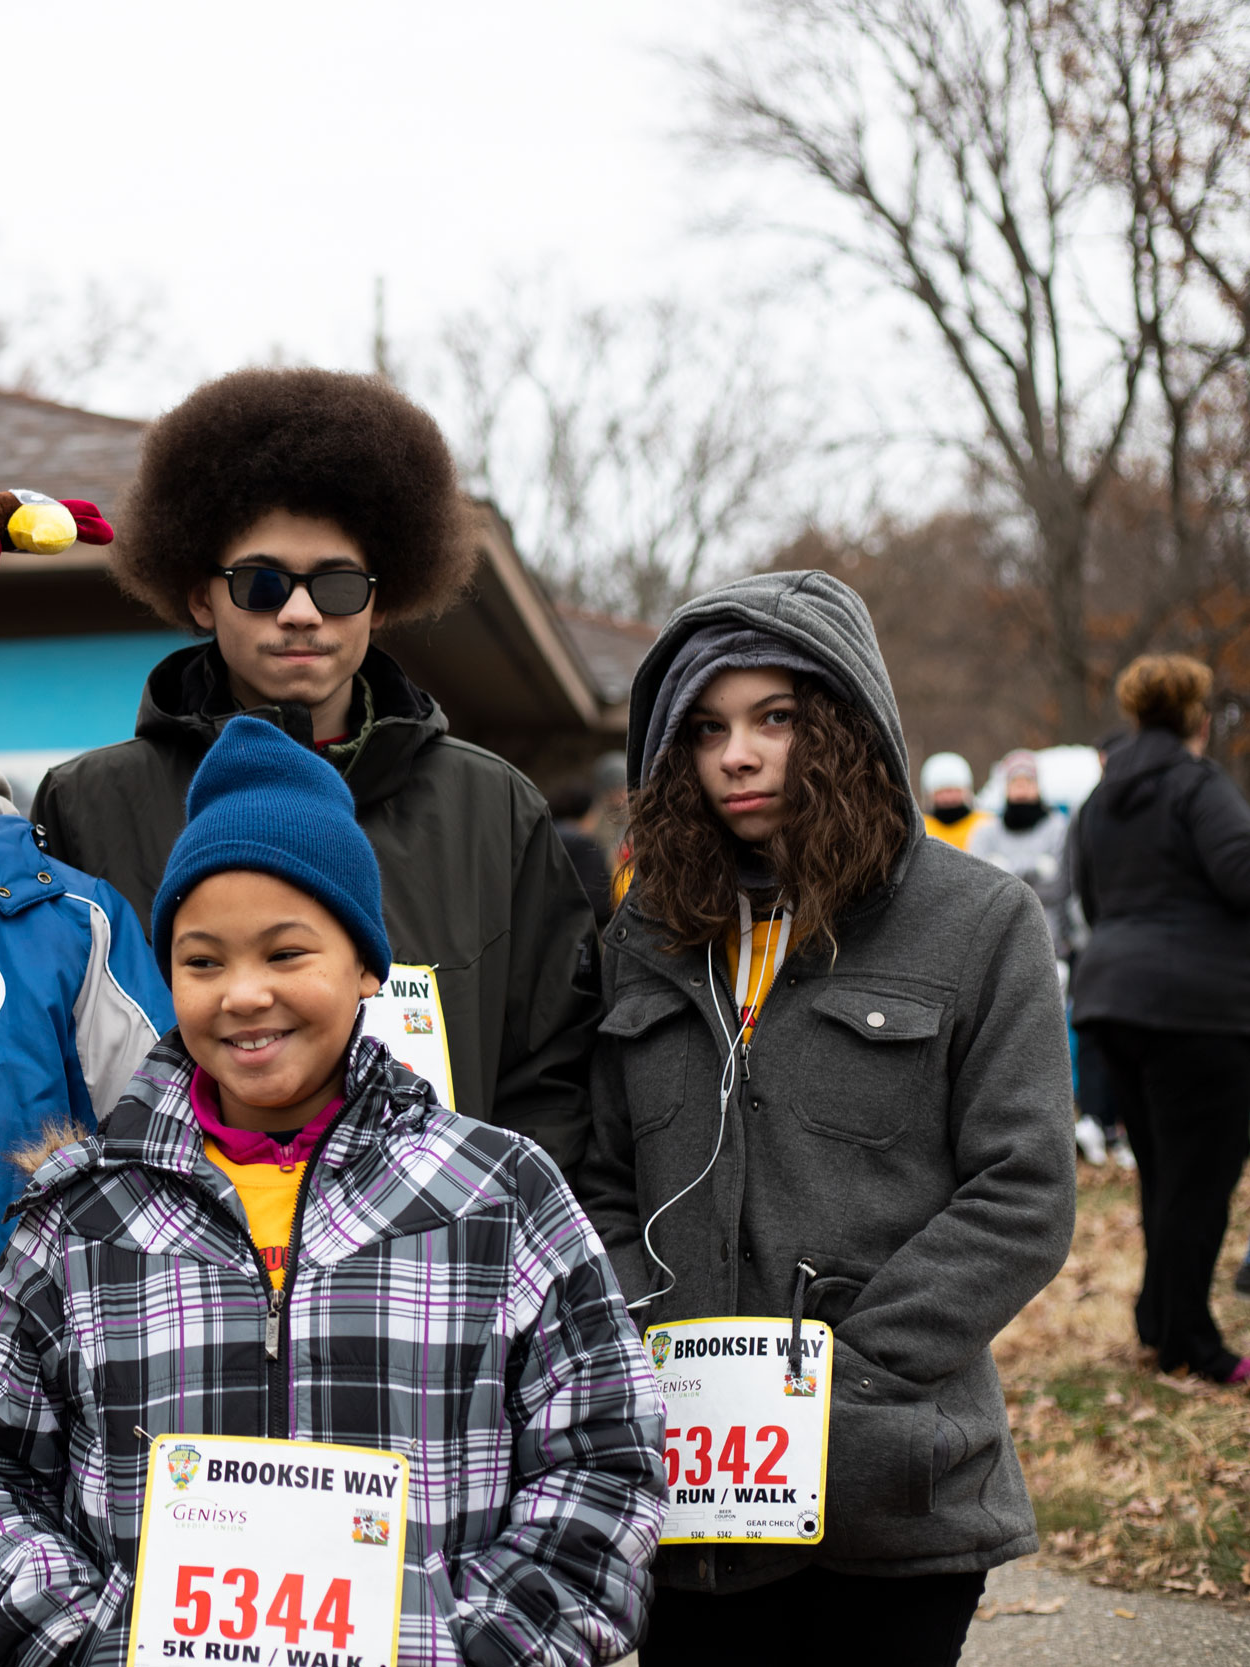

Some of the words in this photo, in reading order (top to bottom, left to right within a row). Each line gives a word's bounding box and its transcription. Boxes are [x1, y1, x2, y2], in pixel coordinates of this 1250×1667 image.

[390, 980, 429, 999] WAY
[674, 1336, 769, 1359] BROOKSIE
[776, 1338, 824, 1358] WAY
[661, 1425, 790, 1487] 5342
[207, 1459, 334, 1491] BROOKSIE
[344, 1470, 398, 1498] WAY
[676, 1488, 715, 1504] RUN
[720, 1488, 728, 1505] /
[735, 1488, 797, 1504] WALK
[690, 1531, 705, 1539] 5342
[716, 1531, 732, 1539] 5342
[746, 1531, 762, 1539] 5342
[173, 1565, 354, 1650] 5344
[162, 1640, 196, 1660] 5K
[205, 1642, 260, 1664] RUN
[268, 1648, 278, 1667] /
[287, 1649, 364, 1667] WALK
